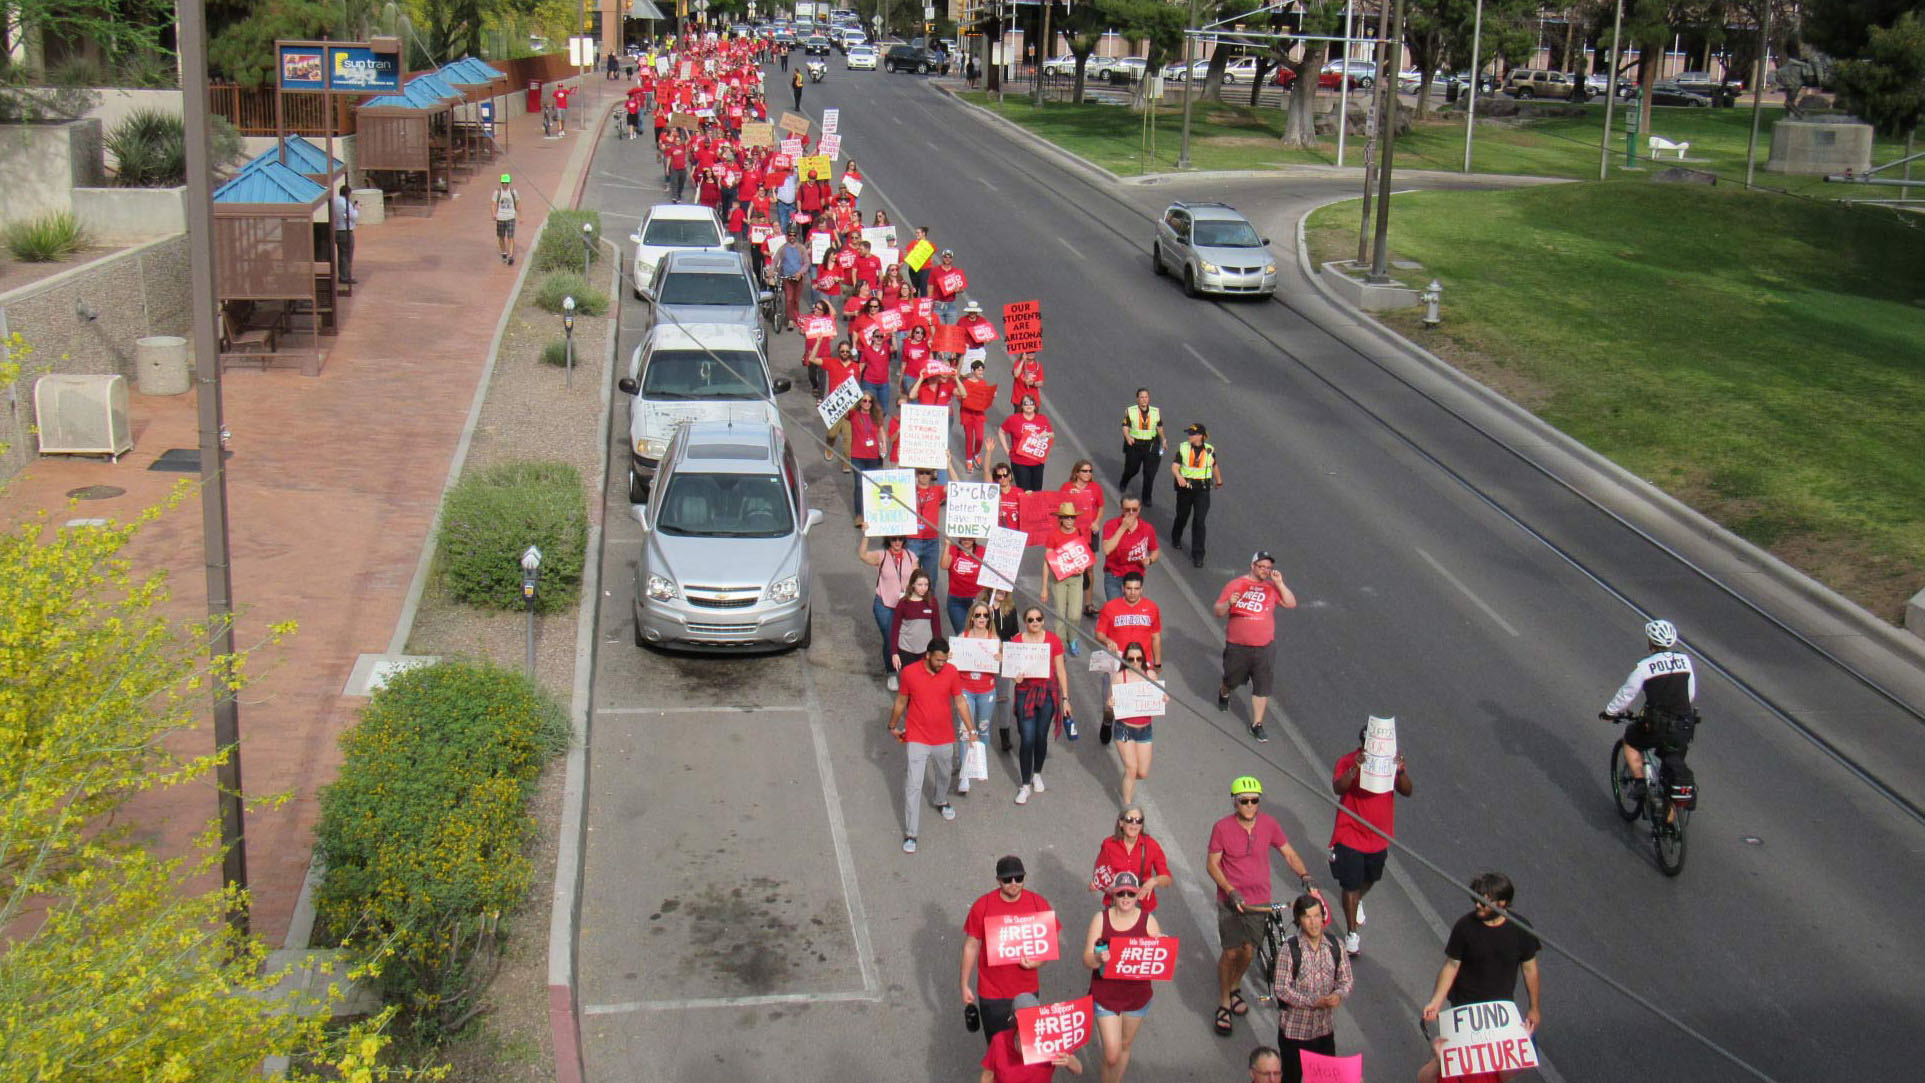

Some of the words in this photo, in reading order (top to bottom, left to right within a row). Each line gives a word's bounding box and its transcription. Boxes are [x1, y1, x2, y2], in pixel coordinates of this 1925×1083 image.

[367, 59, 391, 69] tran
[1011, 303, 1031, 312] OUR
[1013, 322, 1030, 330] ARE
[1007, 341, 1041, 351] FUTURE!
[827, 389, 853, 416] NOT
[829, 392, 859, 425] COMPLY
[949, 501, 977, 512] better
[948, 524, 990, 537] MONEY
[1235, 599, 1263, 612] forED
[1114, 615, 1151, 626] ARIZONA
[1649, 658, 1687, 674] POLICE
[1003, 915, 1012, 924] We
[1013, 912, 1035, 925] Support
[999, 923, 1048, 943] #RED
[998, 939, 1049, 958] forED
[1129, 937, 1138, 945] We
[1139, 938, 1160, 949] Support
[1120, 946, 1168, 961] #RED
[1116, 960, 1165, 975] forED
[1039, 1006, 1050, 1015] We
[1051, 1003, 1075, 1016] Support
[1034, 1011, 1085, 1036] #RED
[1453, 1003, 1510, 1033] FUND
[1034, 1028, 1085, 1055] forED
[1443, 1038, 1535, 1077] FUTURE
